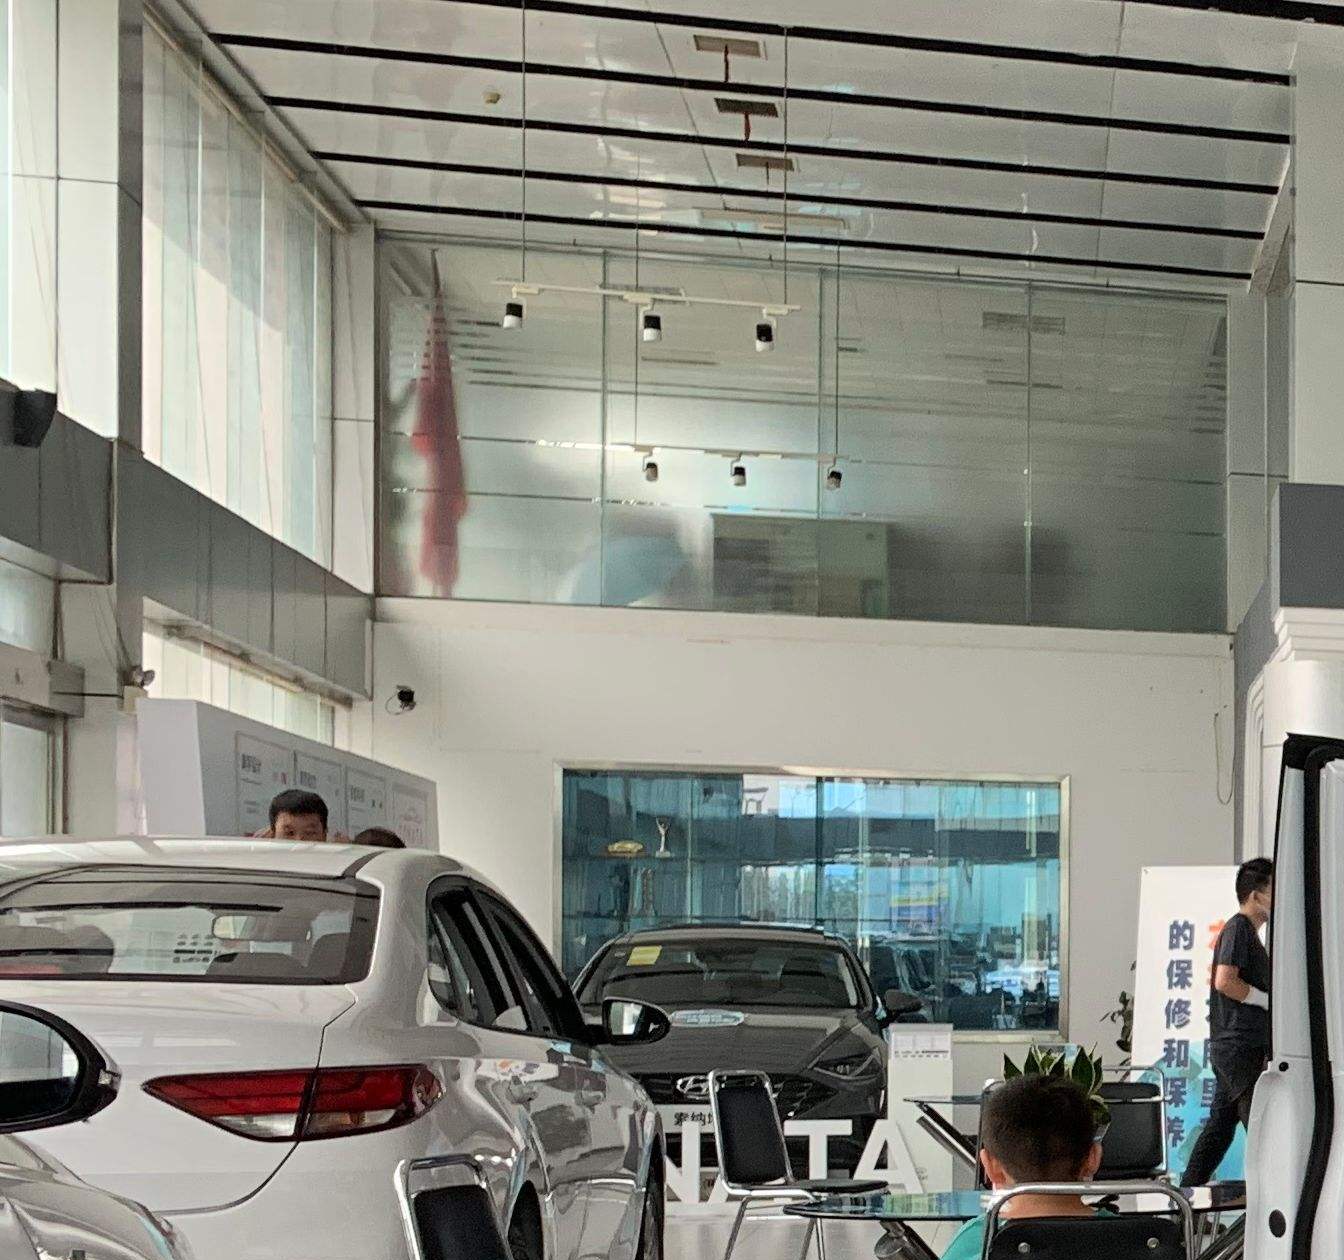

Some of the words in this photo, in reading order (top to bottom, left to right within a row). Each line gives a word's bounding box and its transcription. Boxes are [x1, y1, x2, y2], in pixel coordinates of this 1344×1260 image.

[1164, 919, 1195, 1148] 的保修和保养
[664, 1119, 924, 1203] NTA
